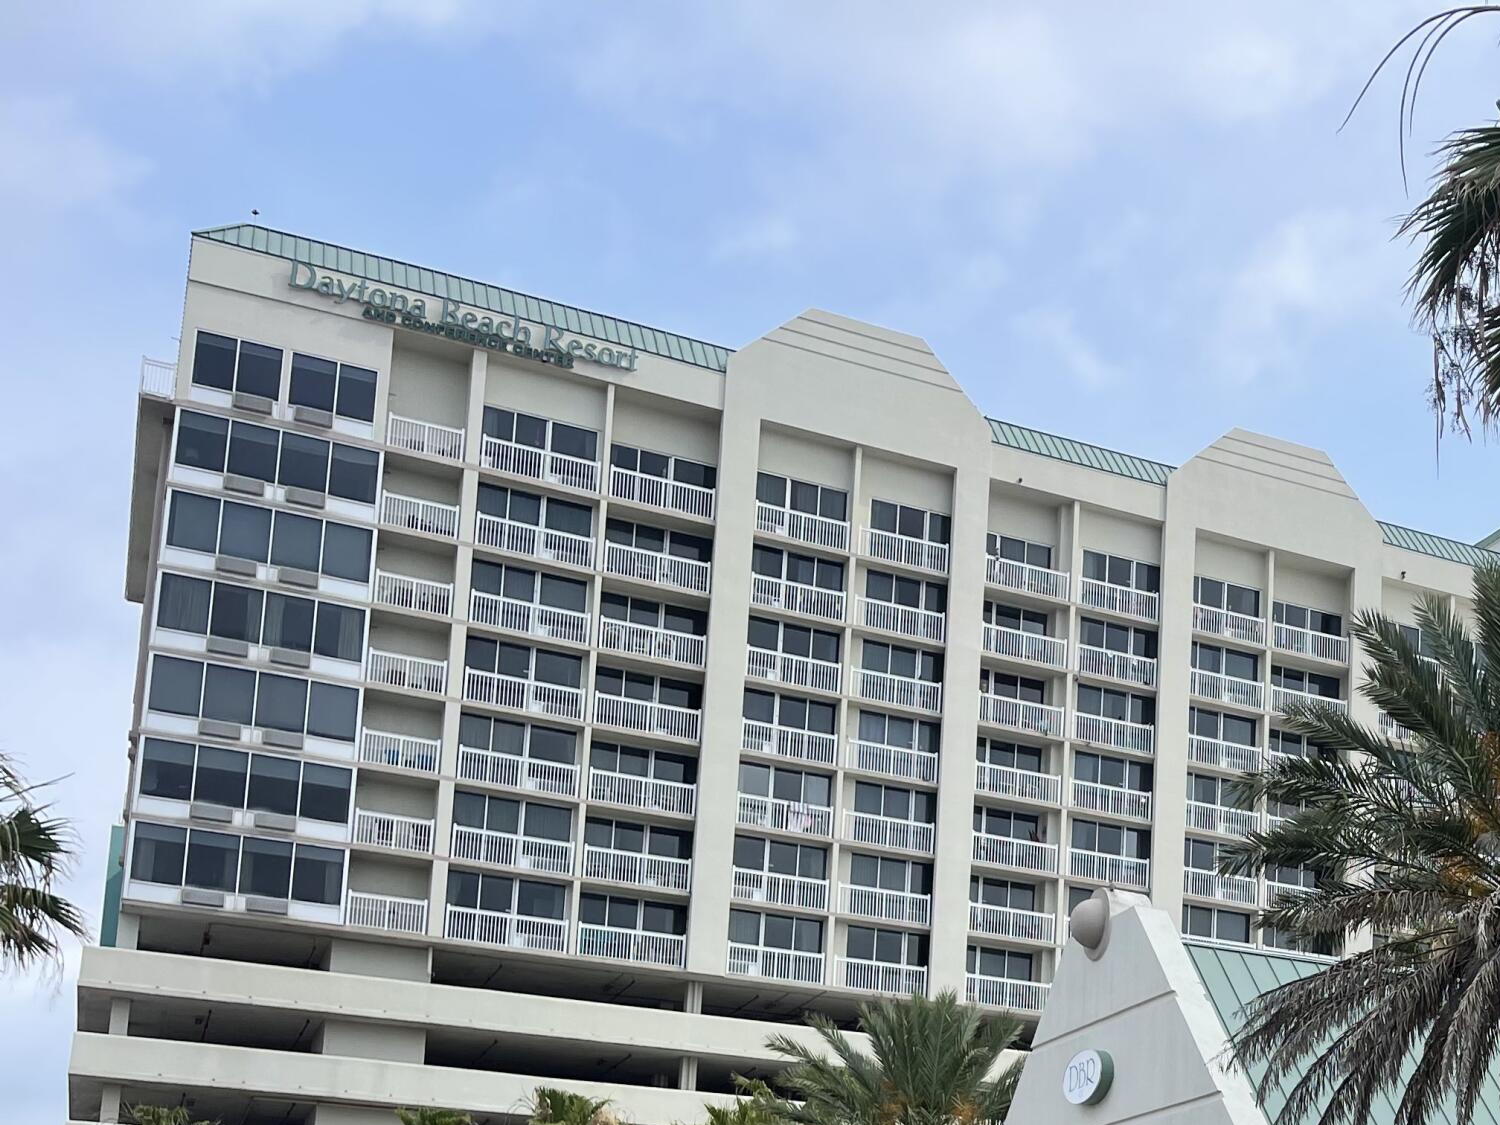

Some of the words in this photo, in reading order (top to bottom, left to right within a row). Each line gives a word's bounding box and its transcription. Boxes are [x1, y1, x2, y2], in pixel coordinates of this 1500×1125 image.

[288, 261, 426, 319] Daytona
[440, 298, 531, 347] Beach
[543, 324, 639, 372] Resort
[361, 306, 397, 323] AND
[1069, 1057, 1095, 1092] DBR
